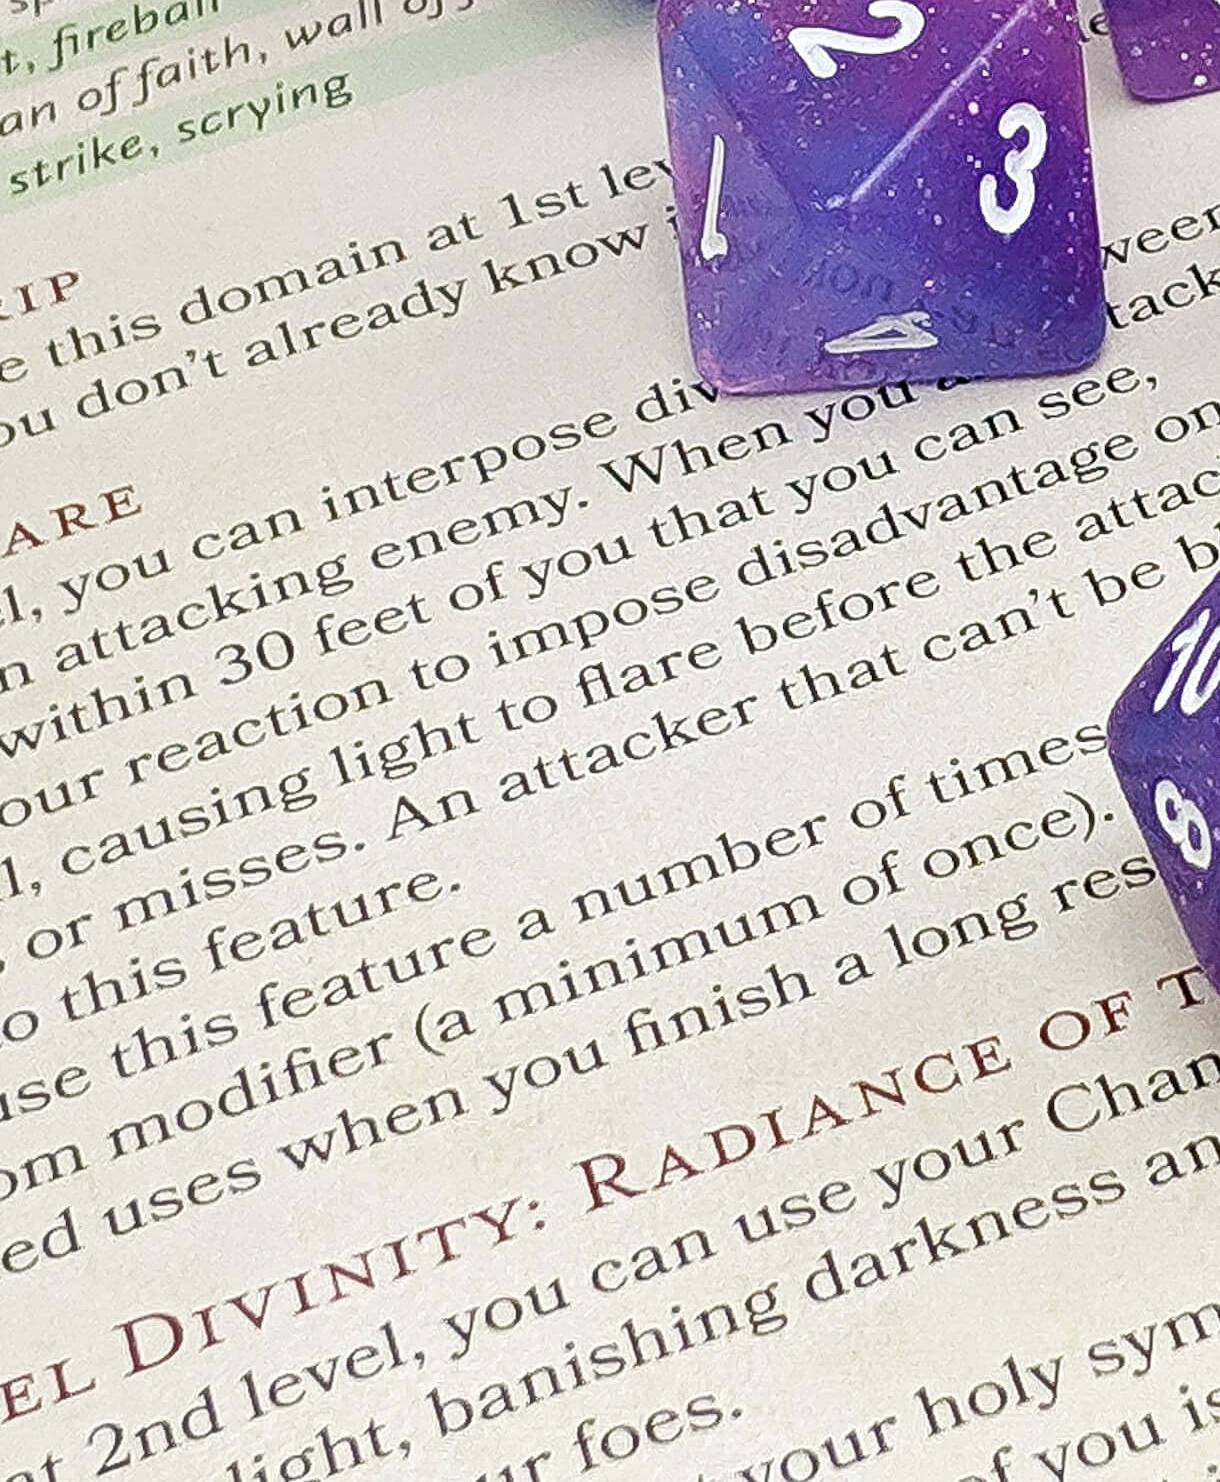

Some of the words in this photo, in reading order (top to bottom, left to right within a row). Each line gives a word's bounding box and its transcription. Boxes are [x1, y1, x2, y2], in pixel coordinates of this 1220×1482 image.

[11, 134, 159, 195] strike,
[177, 73, 353, 143] scrying
[78, 67, 128, 116] of
[133, 36, 267, 107] faith,
[980, 101, 1048, 234] 3
[45, 314, 162, 368] this
[180, 238, 408, 325] domain
[427, 213, 484, 252] at
[499, 180, 591, 229] 1st
[247, 278, 468, 368] already
[482, 222, 649, 295] know
[701, 133, 728, 261] 1
[0, 670, 199, 760] within
[213, 630, 295, 685] 30
[314, 592, 434, 656] feet
[448, 561, 508, 611] of
[520, 532, 635, 599] you
[648, 485, 775, 550] that
[783, 450, 900, 515] you
[914, 406, 1025, 462] can
[1037, 366, 1158, 420] see,
[3, 485, 143, 557] ARE
[54, 553, 355, 673] attacking
[370, 485, 589, 572] enemy.
[597, 419, 793, 495] When
[804, 381, 920, 443] you
[58, 546, 171, 615] you
[191, 508, 304, 561] can
[321, 411, 618, 522] interpose
[125, 675, 395, 784] reaction
[409, 655, 471, 689] to
[487, 575, 721, 667] impose
[737, 432, 1140, 587] disadvantage
[25, 912, 92, 960] or
[116, 830, 366, 931] misses.
[385, 786, 482, 840] An
[499, 694, 759, 802] attacker
[780, 645, 907, 711] that
[1081, 559, 1167, 607] be
[62, 767, 317, 874] causing
[329, 712, 482, 785] light
[497, 694, 558, 731] to
[575, 642, 723, 708] flare
[734, 569, 941, 655] before
[955, 529, 1057, 582] the
[111, 1012, 240, 1079] this
[256, 926, 498, 1030] feature
[516, 907, 556, 942] a
[572, 814, 828, 923] number
[849, 776, 912, 831] of
[926, 722, 1109, 806] times
[1154, 778, 1212, 870] 8
[58, 957, 188, 1022] this
[203, 869, 461, 973] feature.
[108, 1045, 393, 1161] modifier
[414, 1001, 477, 1056] (a
[493, 890, 826, 1023] minimum
[842, 850, 906, 907] of
[922, 790, 1115, 879] once).
[1, 1206, 84, 1273] ed
[104, 1158, 262, 1238] uses
[276, 1085, 469, 1171] when
[484, 1037, 609, 1116] you
[623, 963, 816, 1057] finish
[834, 952, 874, 987] a
[884, 892, 1039, 969] long
[0, 1358, 96, 1424] EL
[112, 1197, 546, 1379] DIVINITY:
[575, 1035, 1013, 1215] RADIANCE
[1039, 991, 1134, 1051] OF
[87, 1385, 224, 1476] 2nd
[240, 1320, 425, 1421] level,
[443, 1278, 571, 1360] you
[592, 1228, 717, 1294] can
[733, 1179, 857, 1245] use
[871, 1118, 1024, 1209] your
[425, 1283, 788, 1437] banishing
[804, 1168, 1126, 1302] darkness
[574, 1392, 743, 1473] foes.
[916, 1354, 1064, 1439] holy
[1036, 1414, 1167, 1482] you
